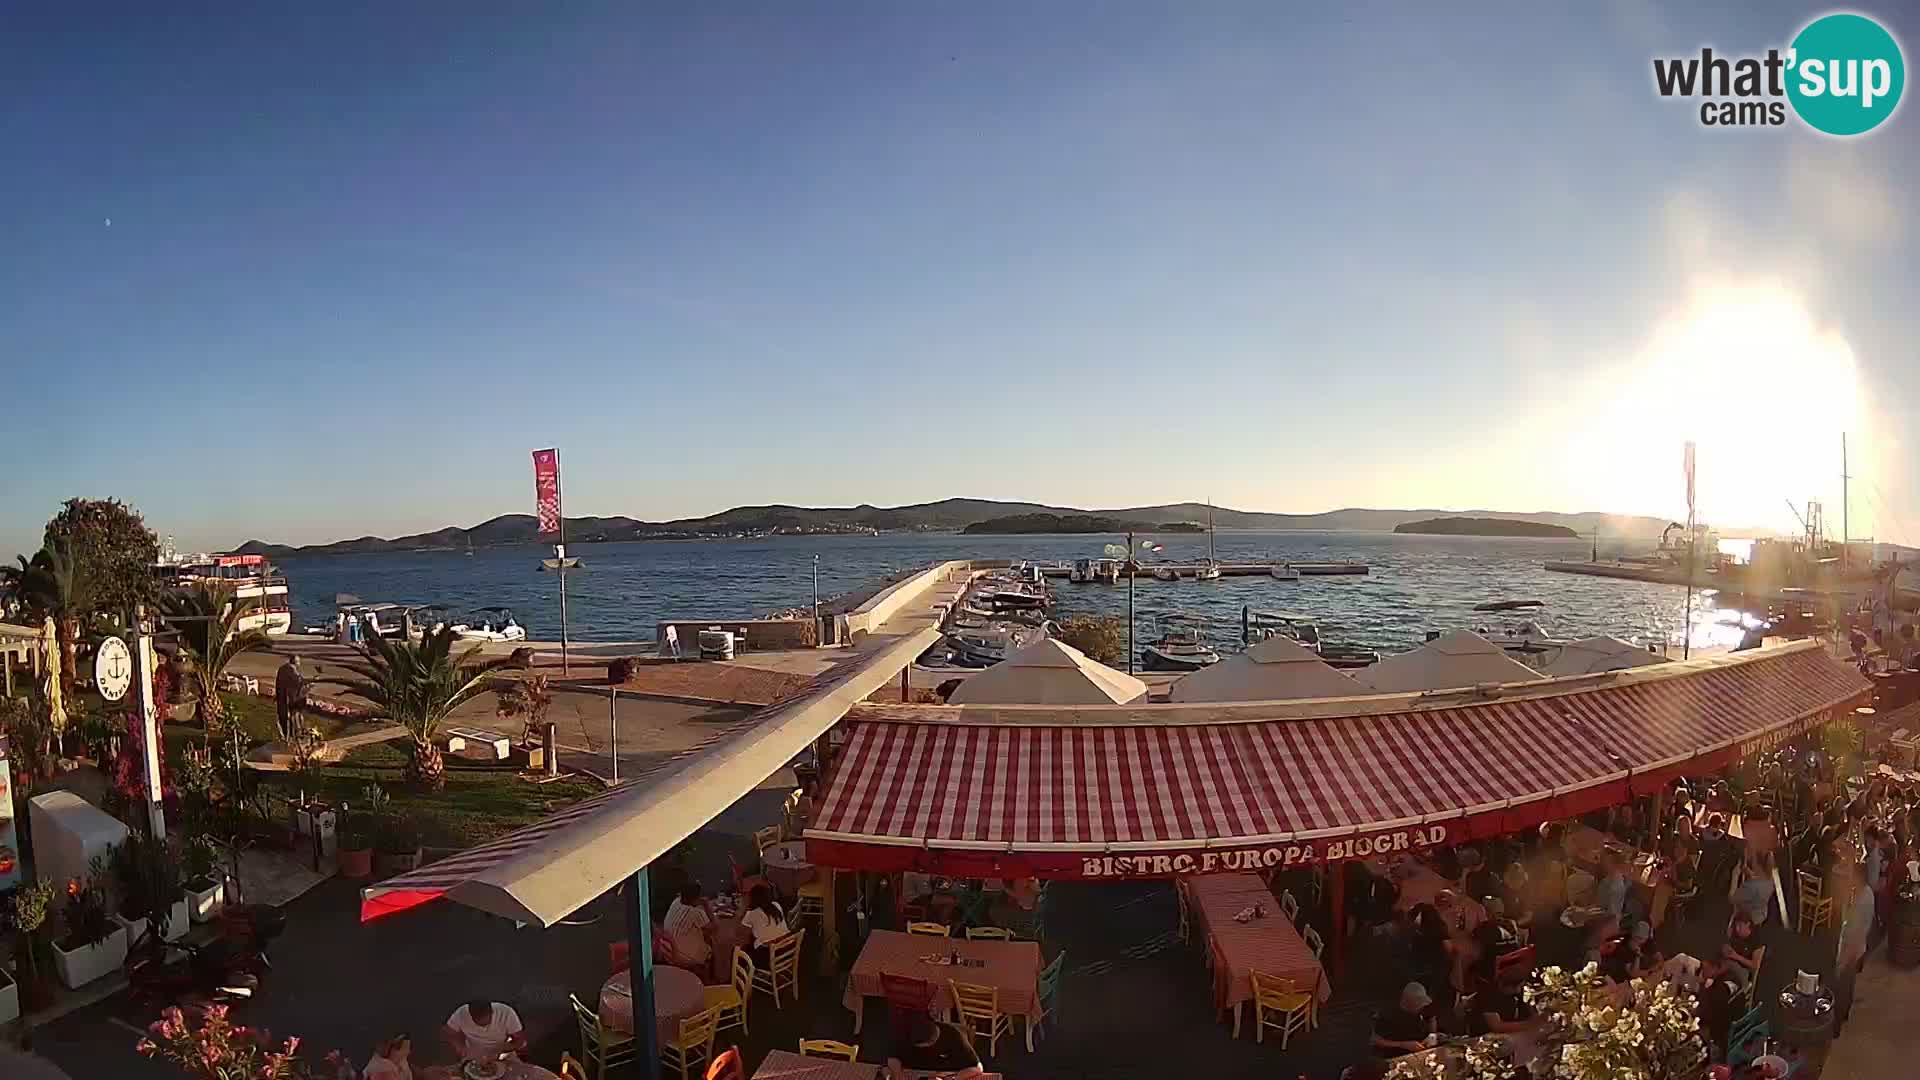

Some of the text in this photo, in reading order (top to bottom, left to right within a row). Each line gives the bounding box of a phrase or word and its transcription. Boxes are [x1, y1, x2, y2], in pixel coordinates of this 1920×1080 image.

[1081, 826, 1446, 876] BISTRO EUROPA BIOGRAD
